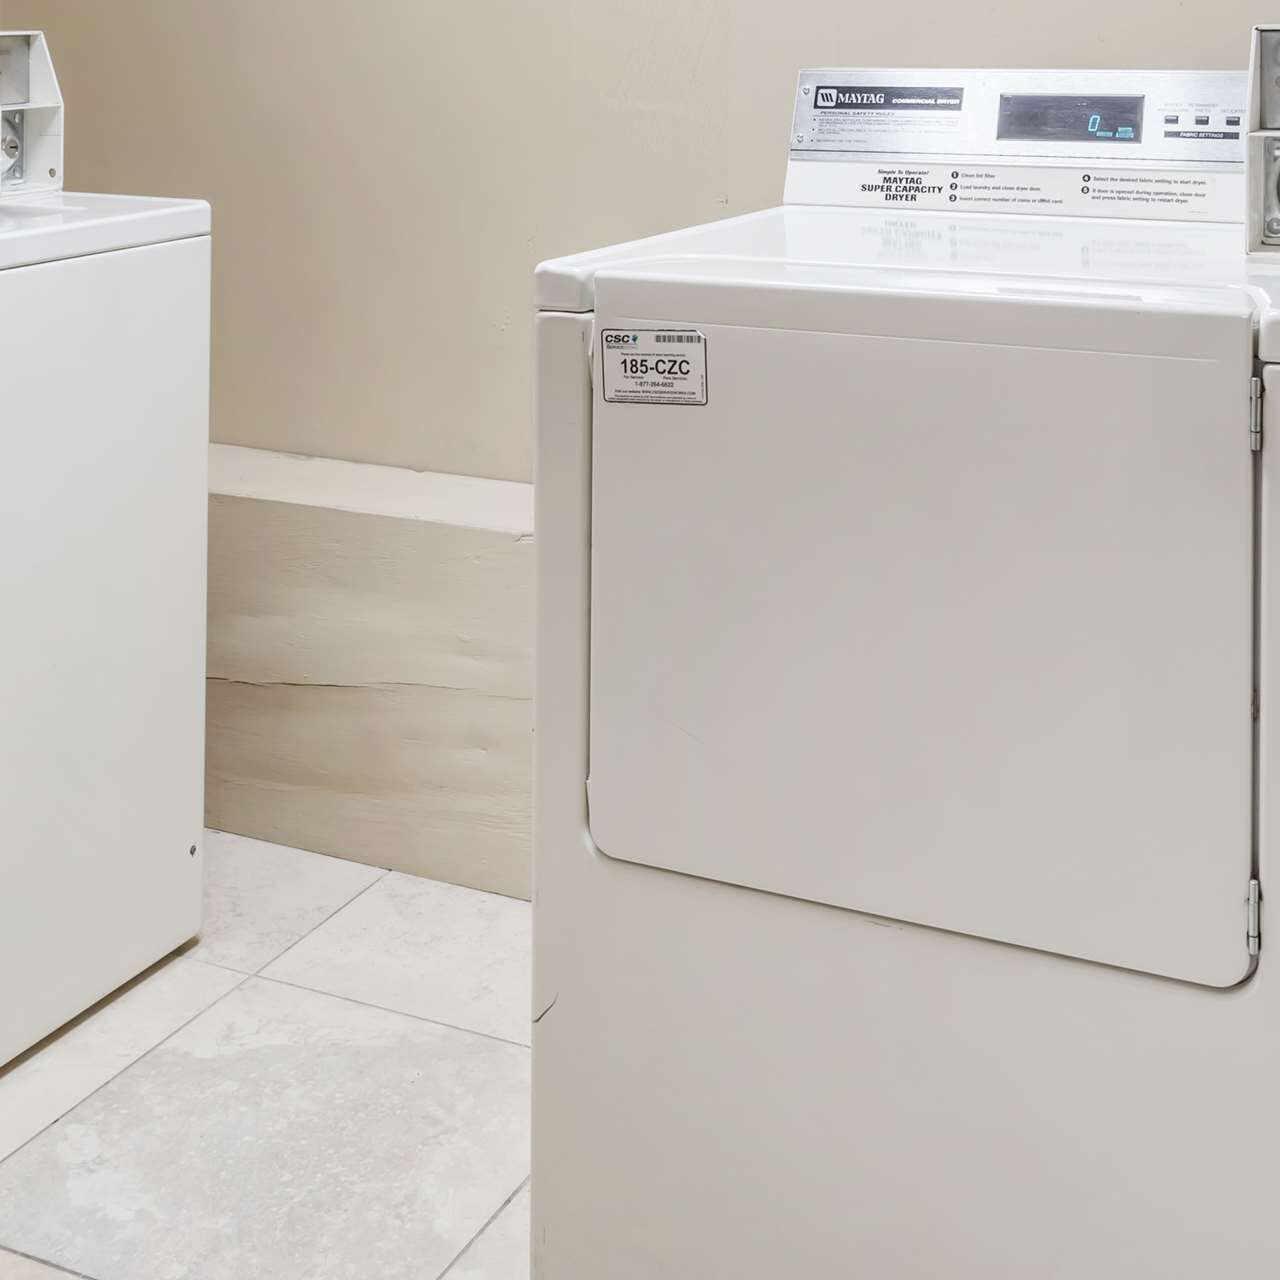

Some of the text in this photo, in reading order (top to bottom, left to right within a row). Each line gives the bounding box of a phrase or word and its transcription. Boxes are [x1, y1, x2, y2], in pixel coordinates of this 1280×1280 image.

[838, 93, 885, 104] MAYTAG
[1088, 115, 1101, 132] 0
[882, 176, 922, 185] MAYTAG
[861, 184, 893, 192] SUPER
[895, 185, 943, 194] CAPACITY
[885, 193, 917, 202] DRYER
[605, 334, 630, 343] CSC
[621, 358, 690, 375] 185-CZC
